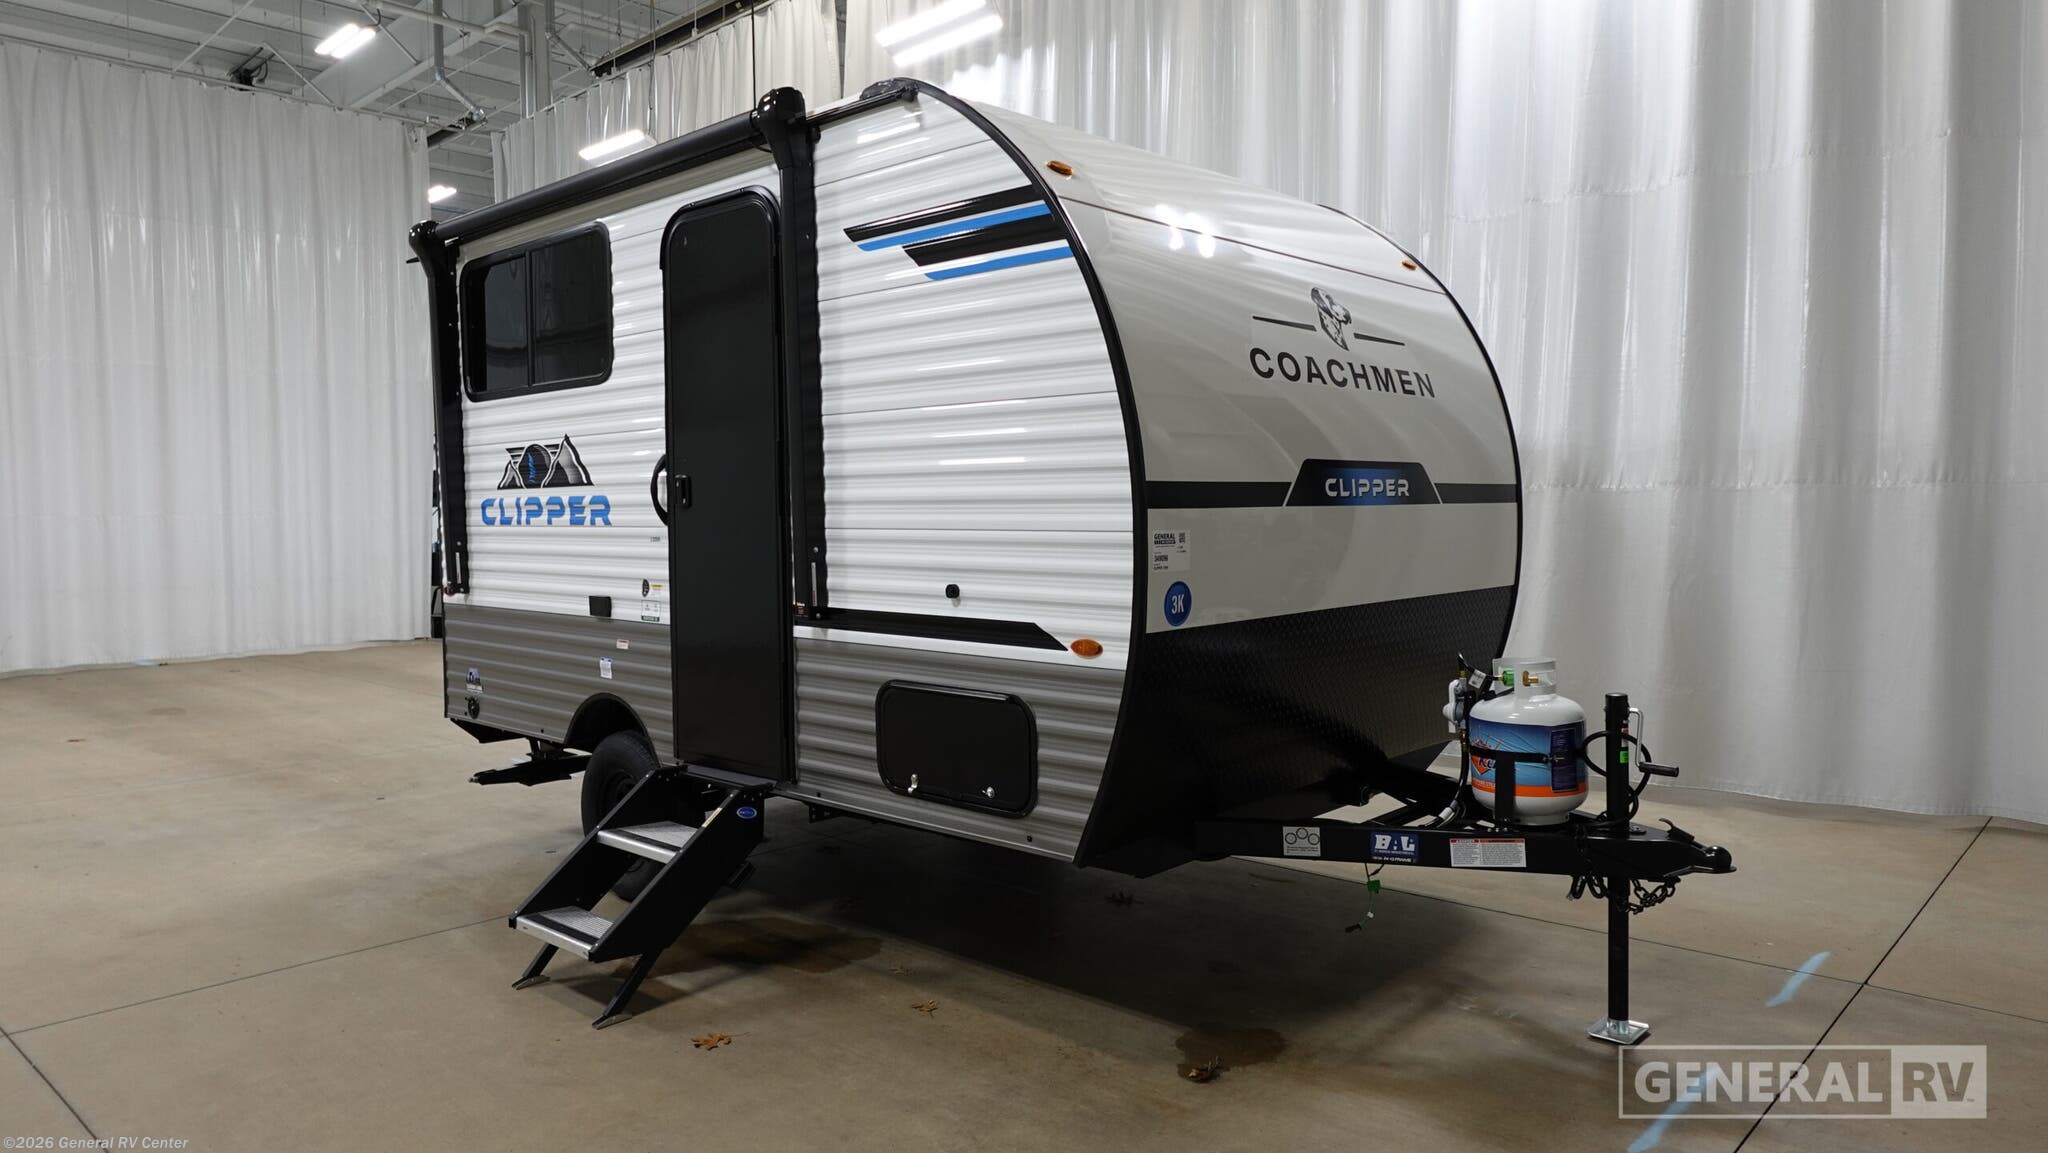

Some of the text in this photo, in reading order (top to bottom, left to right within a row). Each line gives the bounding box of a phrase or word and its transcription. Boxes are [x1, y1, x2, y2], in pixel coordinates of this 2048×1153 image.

[1250, 347, 1436, 399] COACHMEN
[1325, 478, 1410, 497] CLIPPER
[480, 495, 612, 526] CLIPPER
[1171, 594, 1185, 614] 3K
